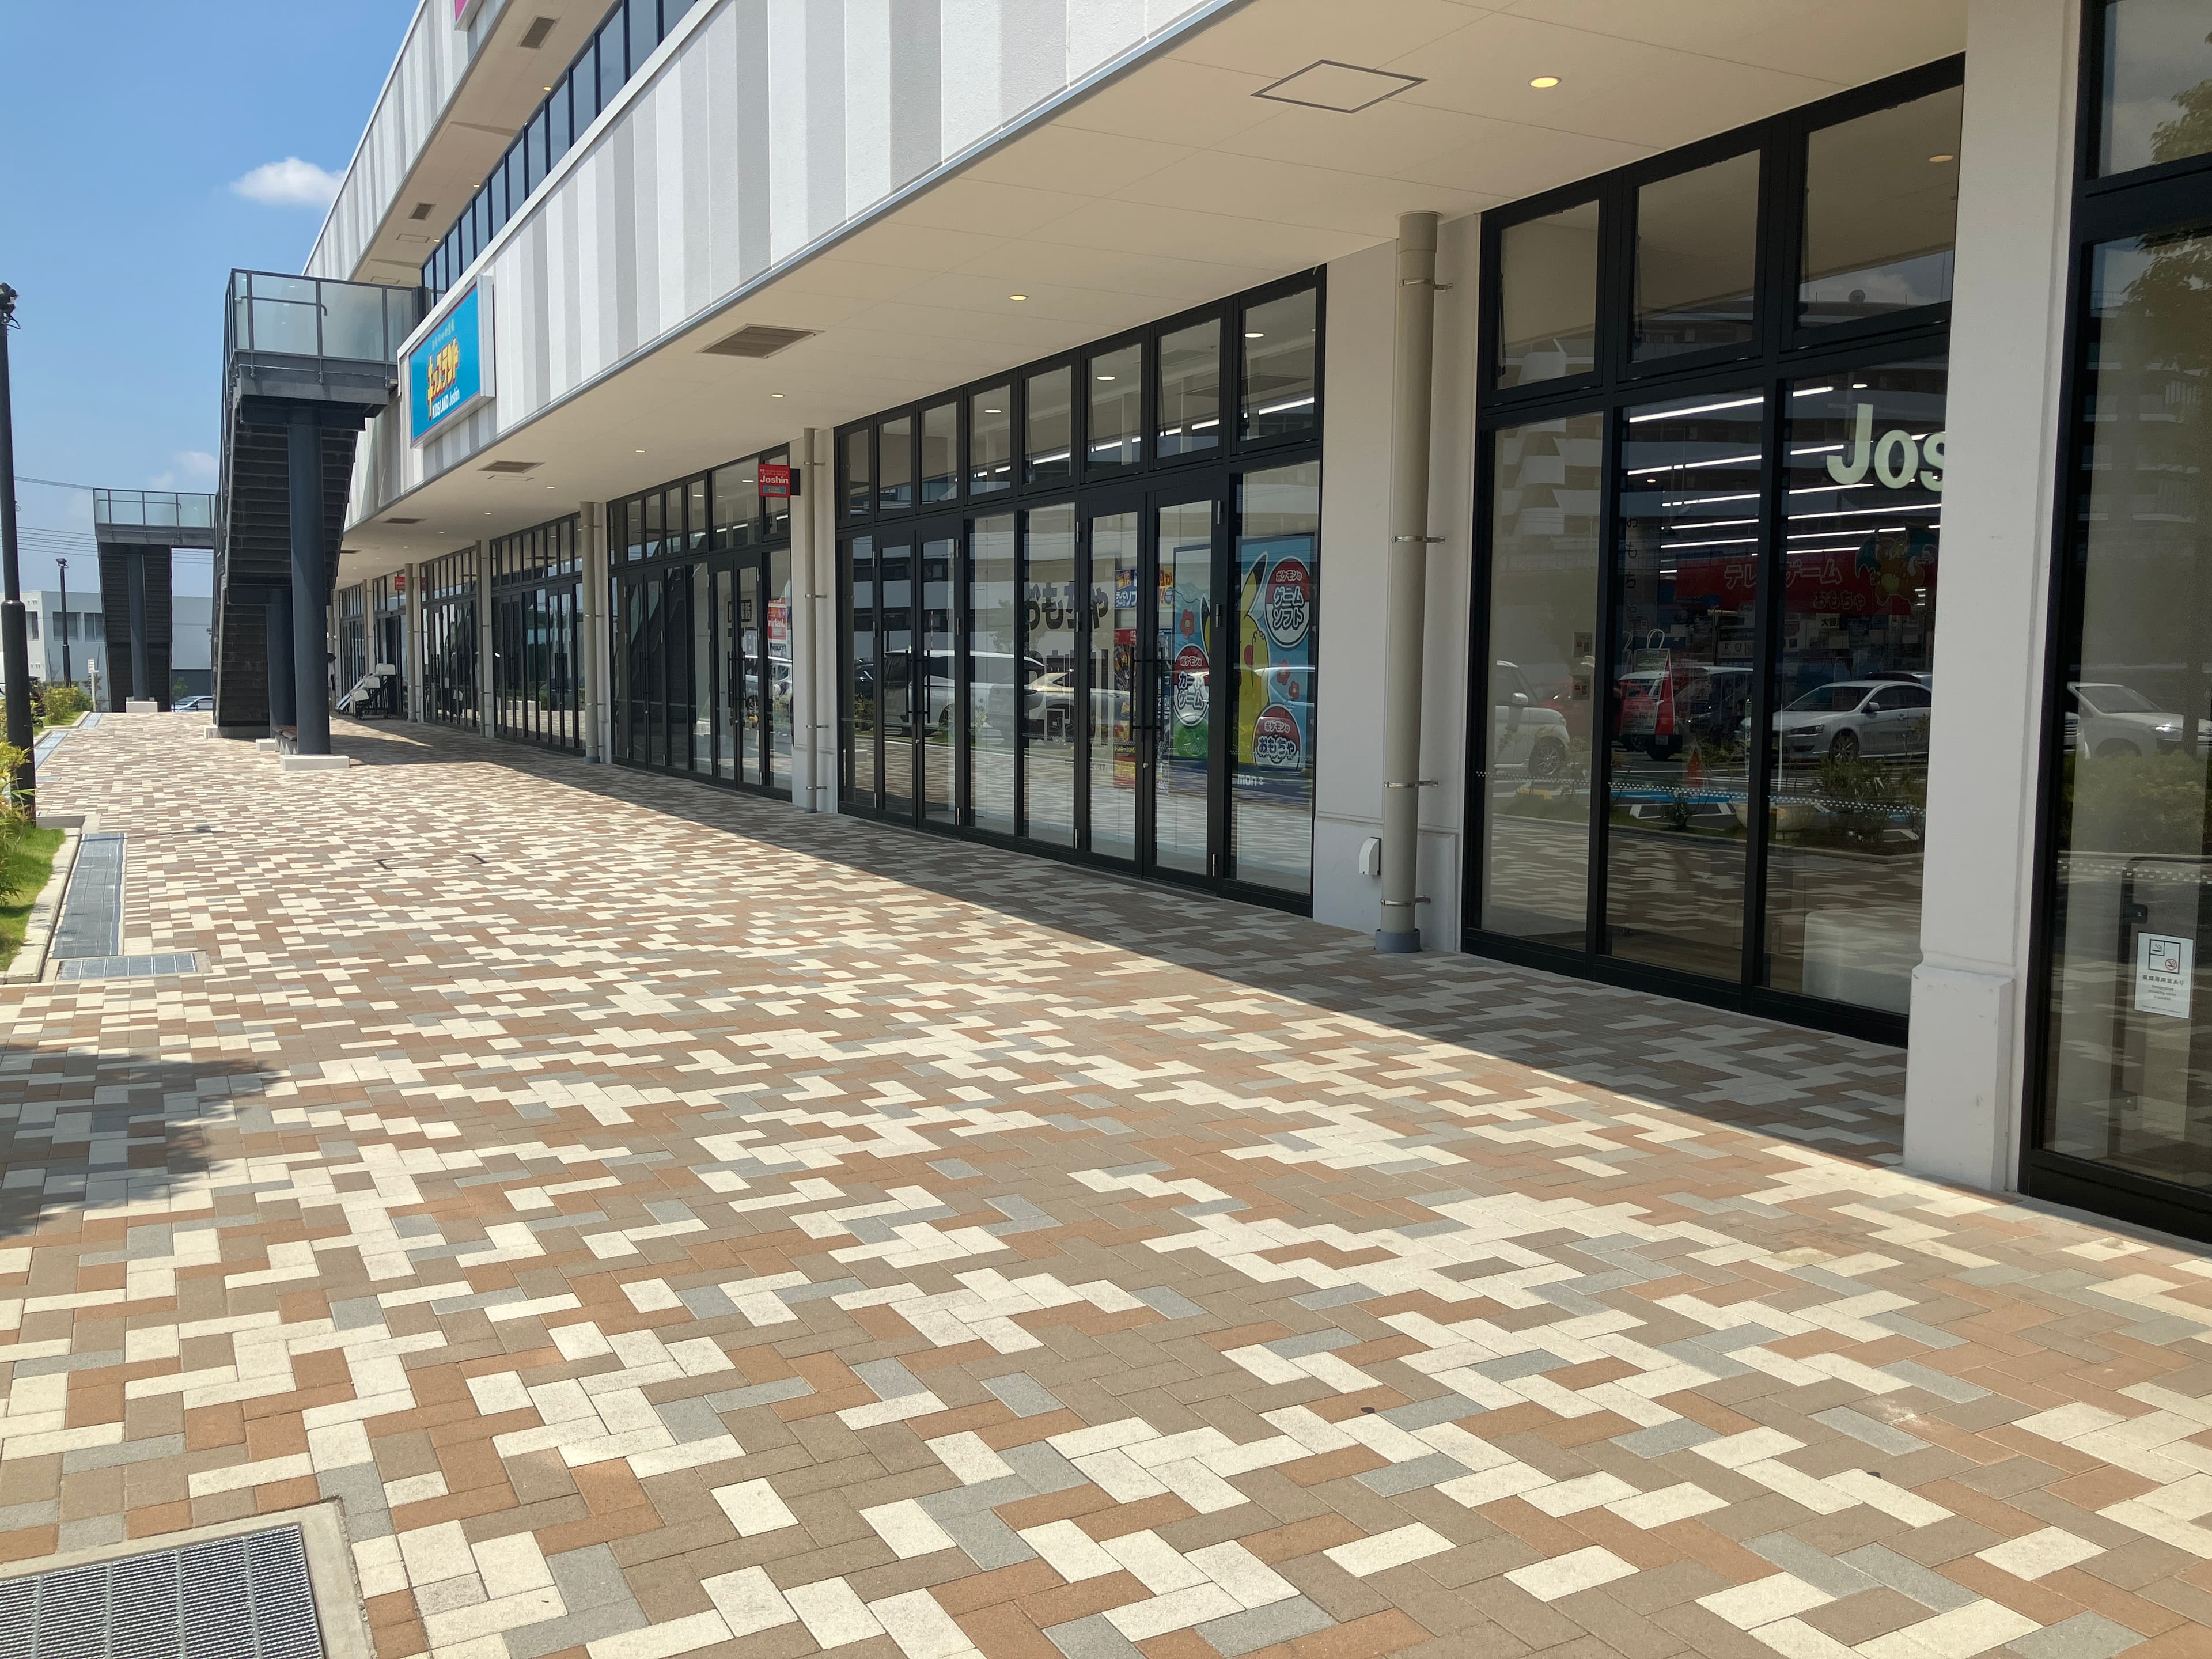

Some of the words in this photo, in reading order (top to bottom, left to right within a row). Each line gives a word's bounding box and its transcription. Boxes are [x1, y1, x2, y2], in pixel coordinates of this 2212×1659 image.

[449, 386, 460, 407] Joshin
[760, 475, 789, 484] Joshin
[1276, 570, 1302, 582] ポケモンの
[1274, 586, 1304, 607] ゲーム
[1813, 589, 1866, 611] おもちゃ
[1273, 608, 1304, 628] ソフト
[1180, 656, 1202, 666] ポケモンの
[1179, 689, 1203, 709] ゲーム
[1264, 721, 1290, 733] ポケモンの
[1258, 736, 1296, 756] おもちゃ
